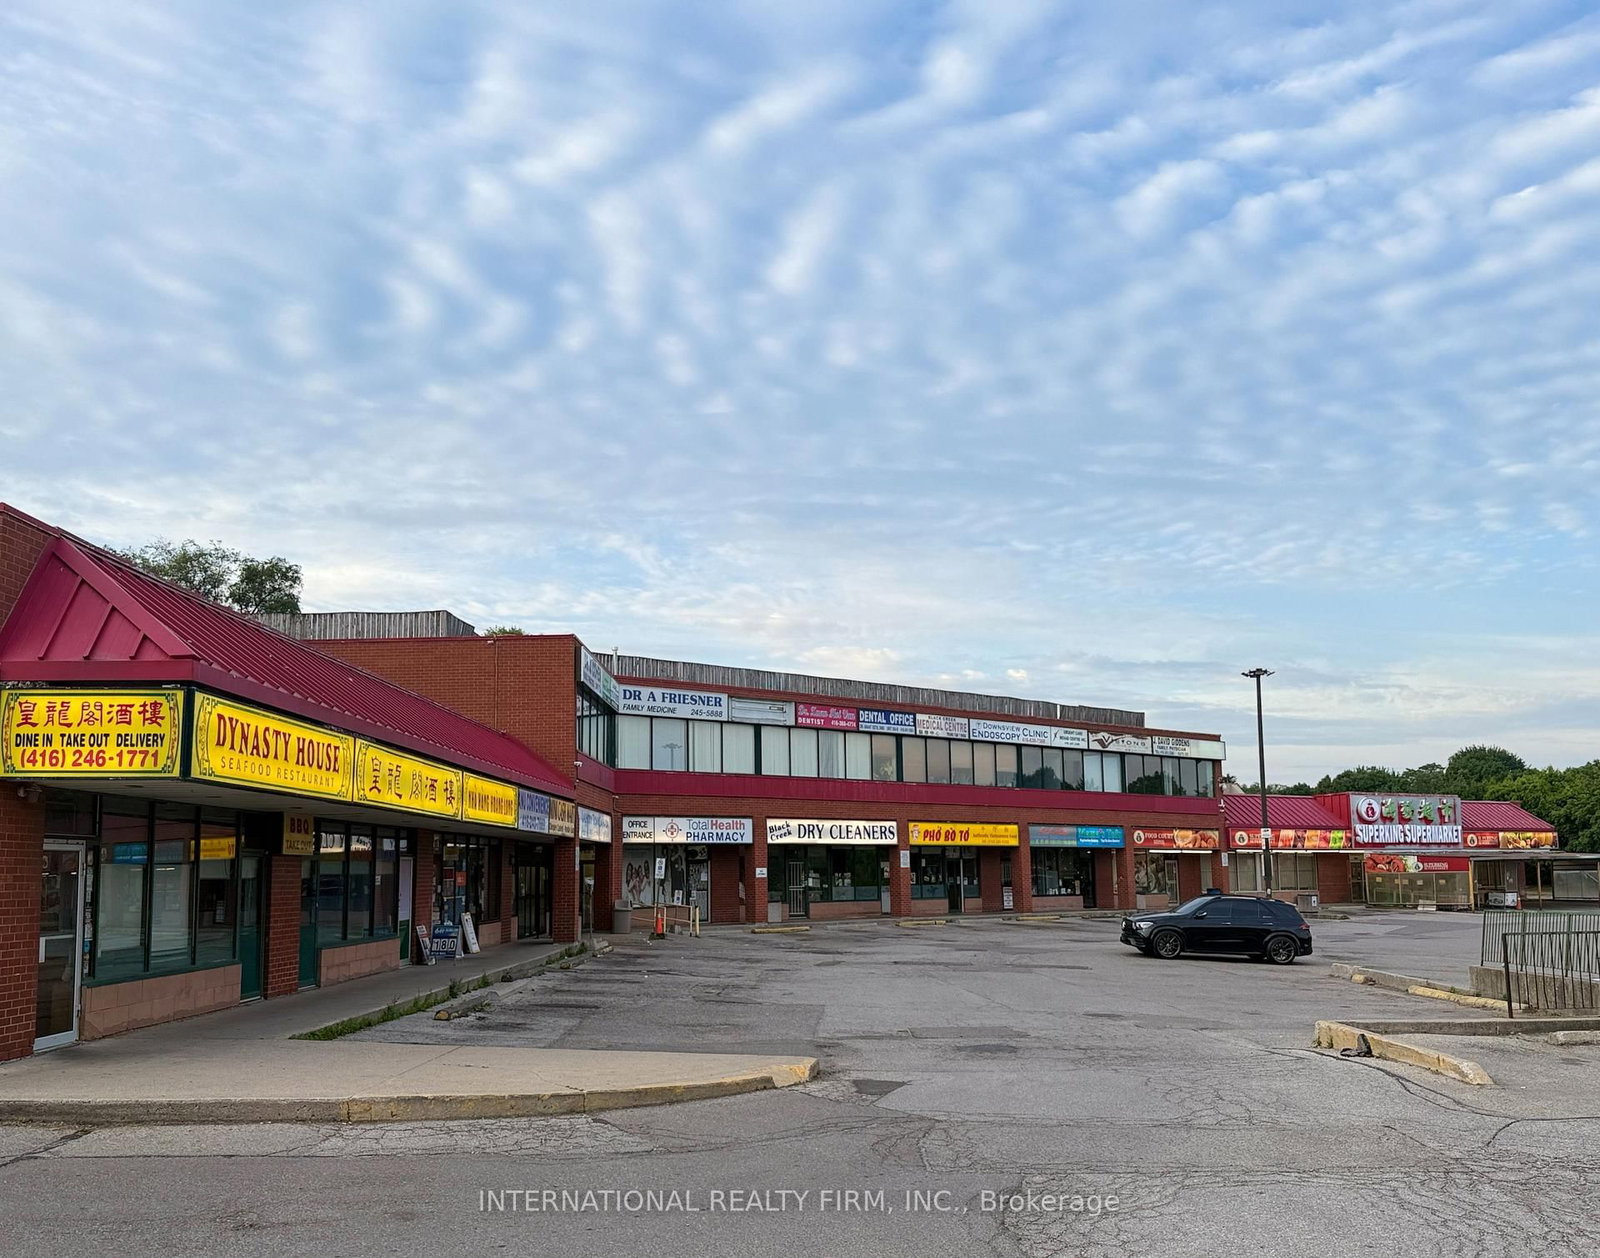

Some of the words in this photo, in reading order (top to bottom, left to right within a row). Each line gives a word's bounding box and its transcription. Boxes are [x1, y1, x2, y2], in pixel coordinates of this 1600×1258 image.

[623, 688, 642, 701] DR
[648, 690, 657, 702] A
[661, 692, 723, 707] FRIESNER
[16, 700, 166, 728] 皇龍閣酒樓
[622, 703, 646, 712] FAMILY
[646, 705, 678, 714] MEDICINE
[798, 717, 825, 725] DENTIST
[859, 710, 886, 723] DENTAL
[889, 713, 914, 725] OFFICE
[917, 719, 943, 731] MEDICAL
[944, 722, 967, 733] CENTRE
[15, 733, 39, 747] DINE
[41, 733, 53, 747] IN
[60, 733, 87, 747] TAKE
[88, 733, 110, 747] OUT
[116, 733, 166, 748] DELIVERY
[971, 728, 1021, 741] ENDOSCOPY
[1022, 728, 1049, 739] CLINIC
[215, 713, 291, 758] DYNASTY
[295, 734, 341, 772] HOUSE
[20, 749, 67, 769] (416)
[71, 749, 159, 768] 246-1771
[220, 756, 272, 777] SEAFOOD
[277, 767, 335, 788] RESTAURANT
[290, 818, 309, 835] BBQ
[628, 820, 648, 828] OFFICE
[769, 821, 791, 834] Black
[623, 831, 653, 839] ENTRANCE
[686, 832, 745, 842] PHARMACY
[770, 828, 792, 842] Creek
[797, 823, 824, 840] DRY
[829, 824, 896, 841] CLEANERS
[1355, 824, 1405, 844] SUPERKING
[1405, 824, 1462, 844] SUPERMARKET
